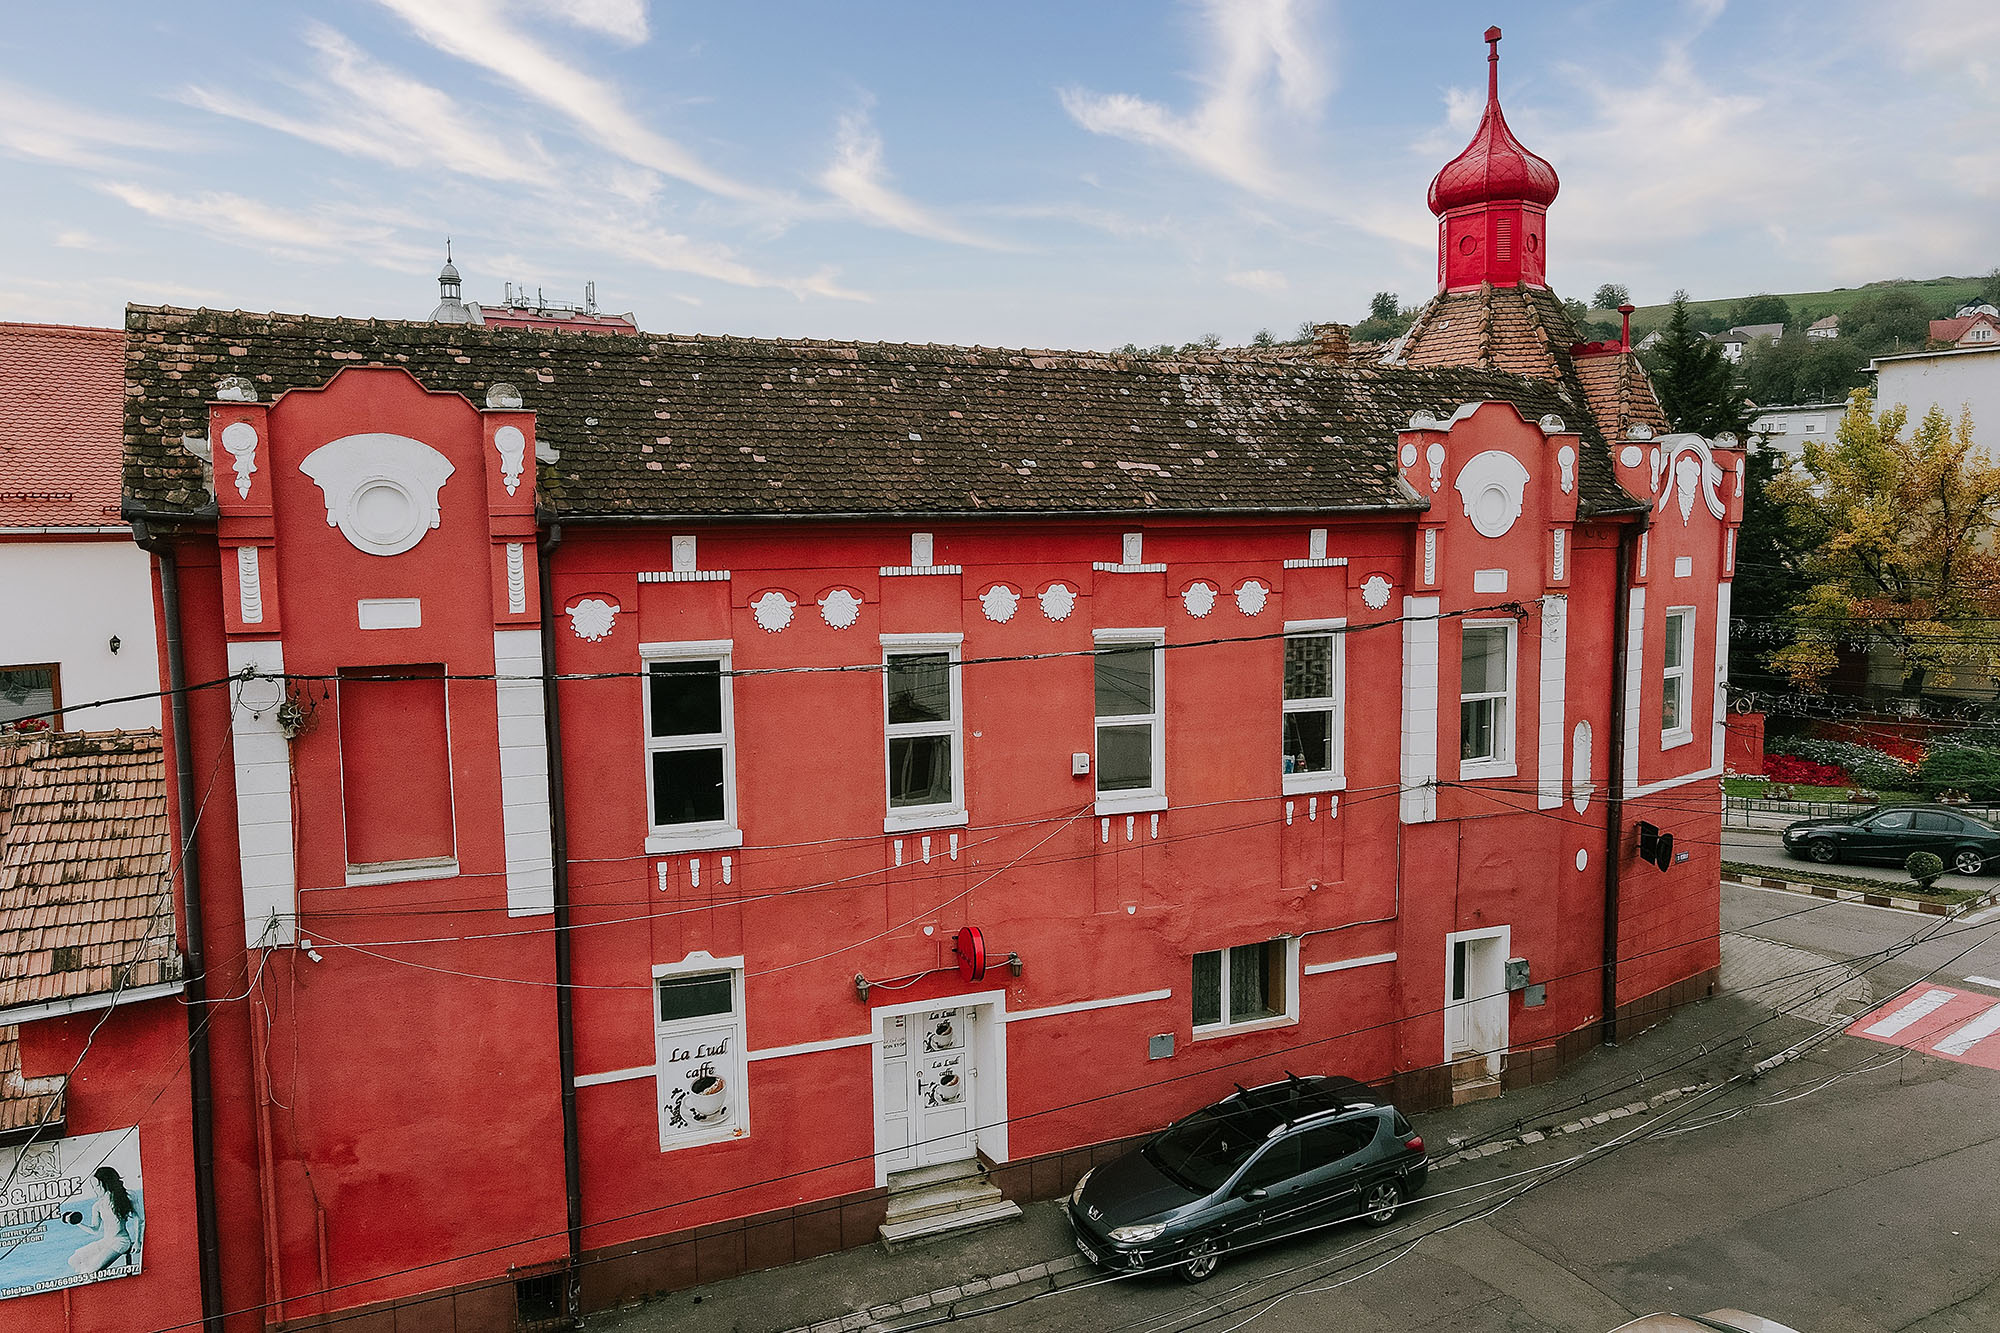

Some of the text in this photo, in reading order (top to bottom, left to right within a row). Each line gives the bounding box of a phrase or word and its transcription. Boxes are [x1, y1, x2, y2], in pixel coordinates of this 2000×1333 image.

[929, 1012, 939, 1020] La
[668, 1036, 731, 1063] La Lud
[685, 1061, 715, 1078] caffe
[28, 1176, 82, 1202] MORE
